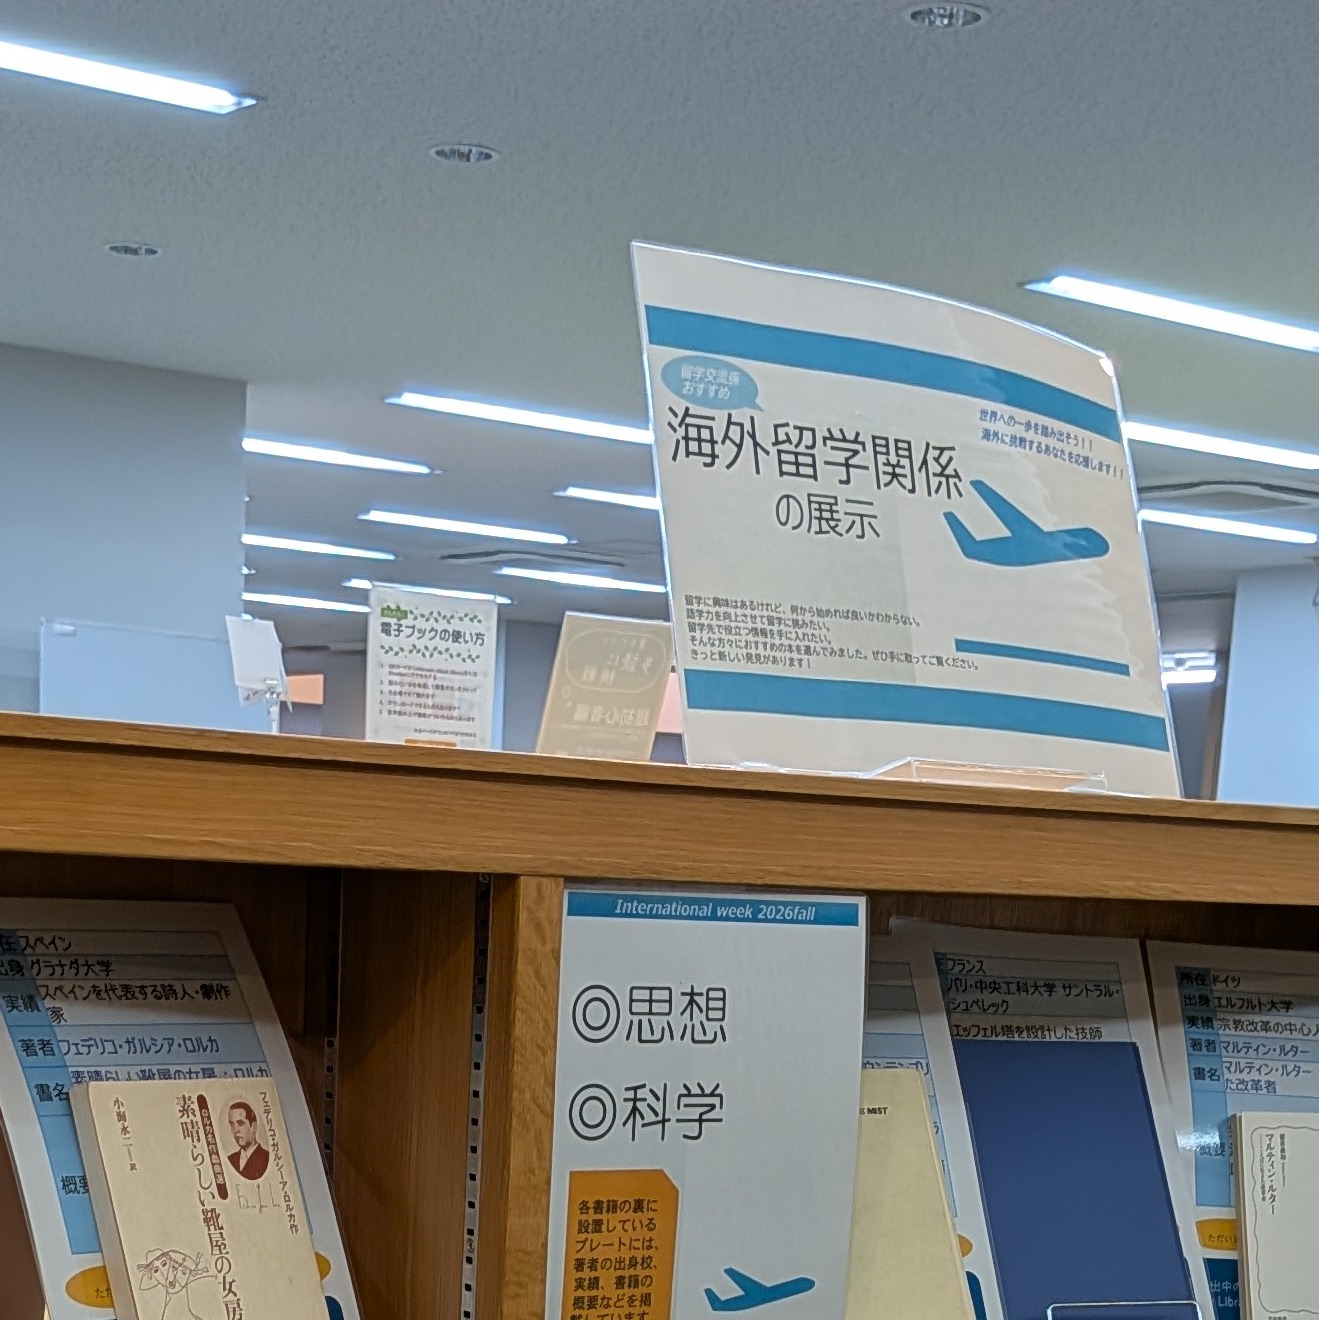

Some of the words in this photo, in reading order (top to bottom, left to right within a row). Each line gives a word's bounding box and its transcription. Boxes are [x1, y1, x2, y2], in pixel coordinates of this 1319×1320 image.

[683, 383, 731, 401] おすすめ
[666, 405, 967, 501] 海外留学関係
[775, 494, 881, 540] の展示
[380, 621, 485, 646] 電子ブックの使い方
[614, 898, 713, 918] International
[716, 903, 754, 919] week
[757, 904, 817, 922] 2026fall
[18, 933, 73, 953] スペイン
[30, 958, 116, 978] グラナダ大学
[945, 957, 987, 974] フランス
[1211, 971, 1242, 988] ドイツ
[3, 995, 42, 1014] 実績
[49, 1006, 68, 1025] 家
[1183, 994, 1211, 1009] 出身
[1214, 994, 1294, 1015] エルフルト大学
[1186, 1015, 1216, 1031] 実績
[952, 1024, 1103, 1041] エッフェル塔を設計した技師
[18, 1037, 56, 1058] 著者
[59, 1035, 221, 1058] フェデリコ・ガルシア・ロルカ
[1188, 1036, 1217, 1053] 著者
[1221, 1039, 1310, 1058] マルティン・ルター
[1192, 1066, 1221, 1083] 書名
[34, 1082, 69, 1102] 書名
[1224, 1077, 1278, 1095] た改革者
[1265, 1132, 1278, 1216] マルティン・ルター
[578, 1198, 659, 1215] 各書籍の裏に
[577, 1217, 657, 1235] 設置している
[574, 1236, 660, 1254] プレートには、
[573, 1255, 659, 1273] 著者の出身校、
[573, 1275, 654, 1292] 実績、書籍の
[572, 1294, 653, 1311] 概要などを掲
